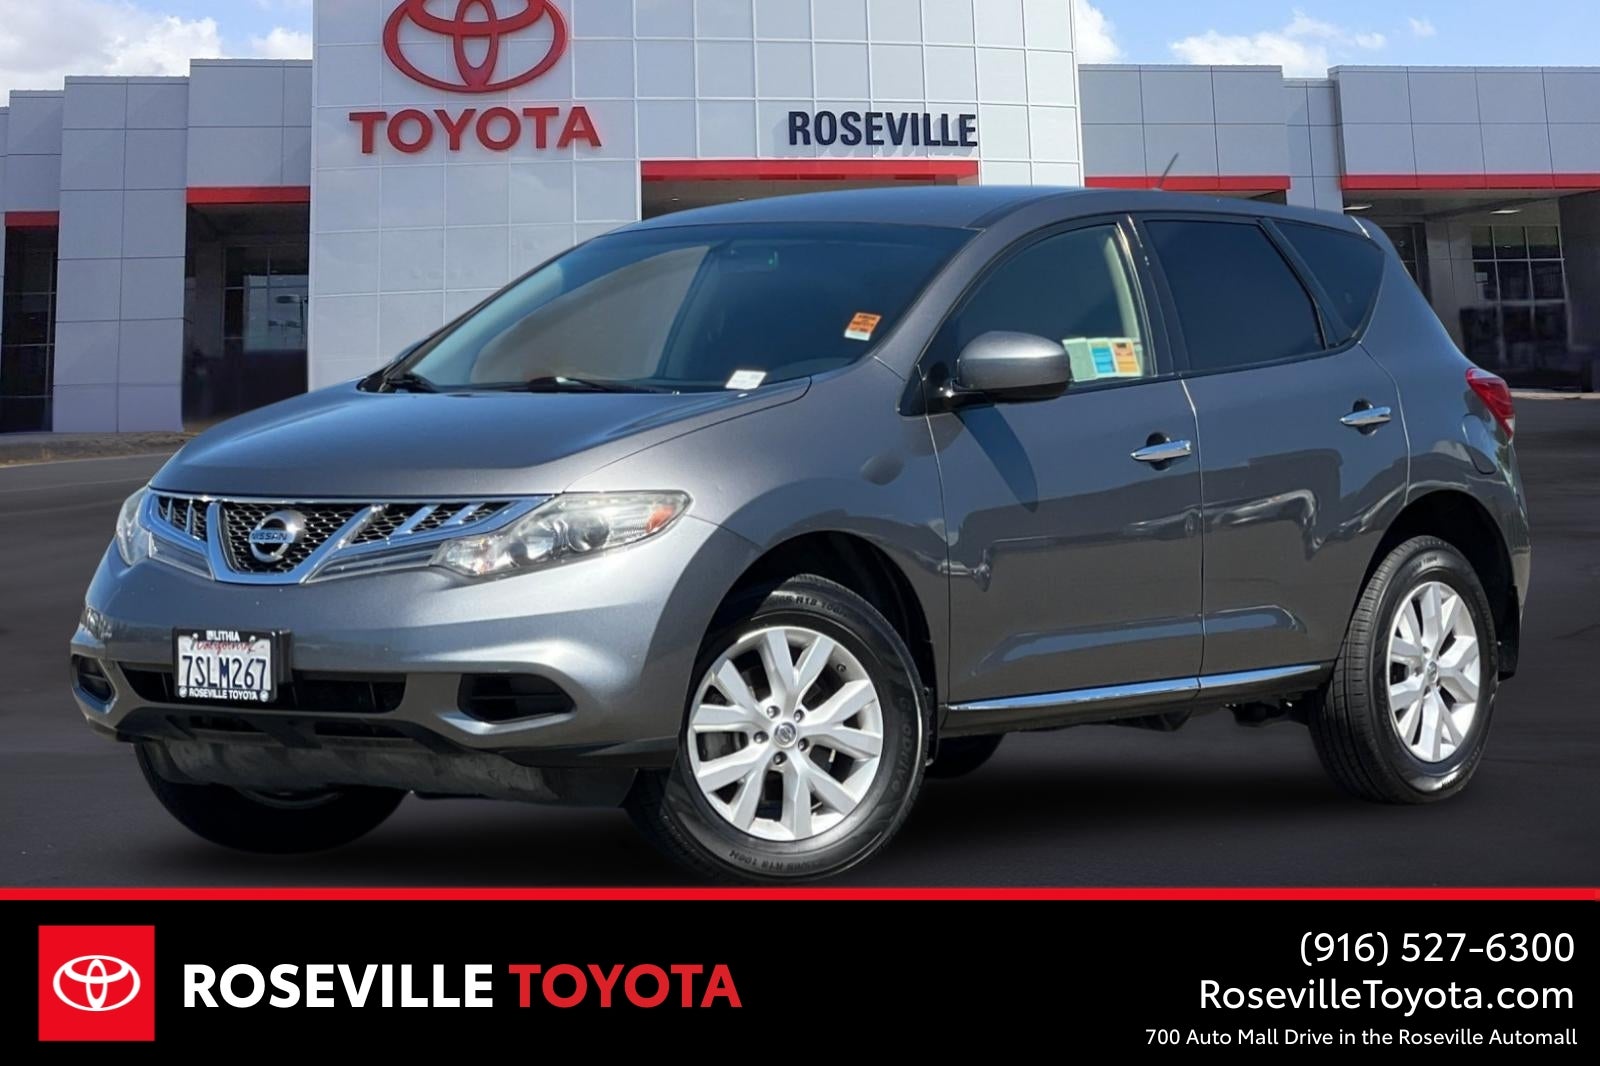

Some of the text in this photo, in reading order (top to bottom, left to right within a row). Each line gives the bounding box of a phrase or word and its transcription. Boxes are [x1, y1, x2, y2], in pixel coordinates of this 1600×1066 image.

[349, 106, 602, 154] TOYOTA
[788, 110, 978, 147] ROSEVILLE
[251, 531, 288, 541] NISSAN
[215, 630, 241, 642] LITHIA
[182, 655, 267, 691] 7SLM267
[188, 687, 259, 700] ROSEVILLE TOYOTA
